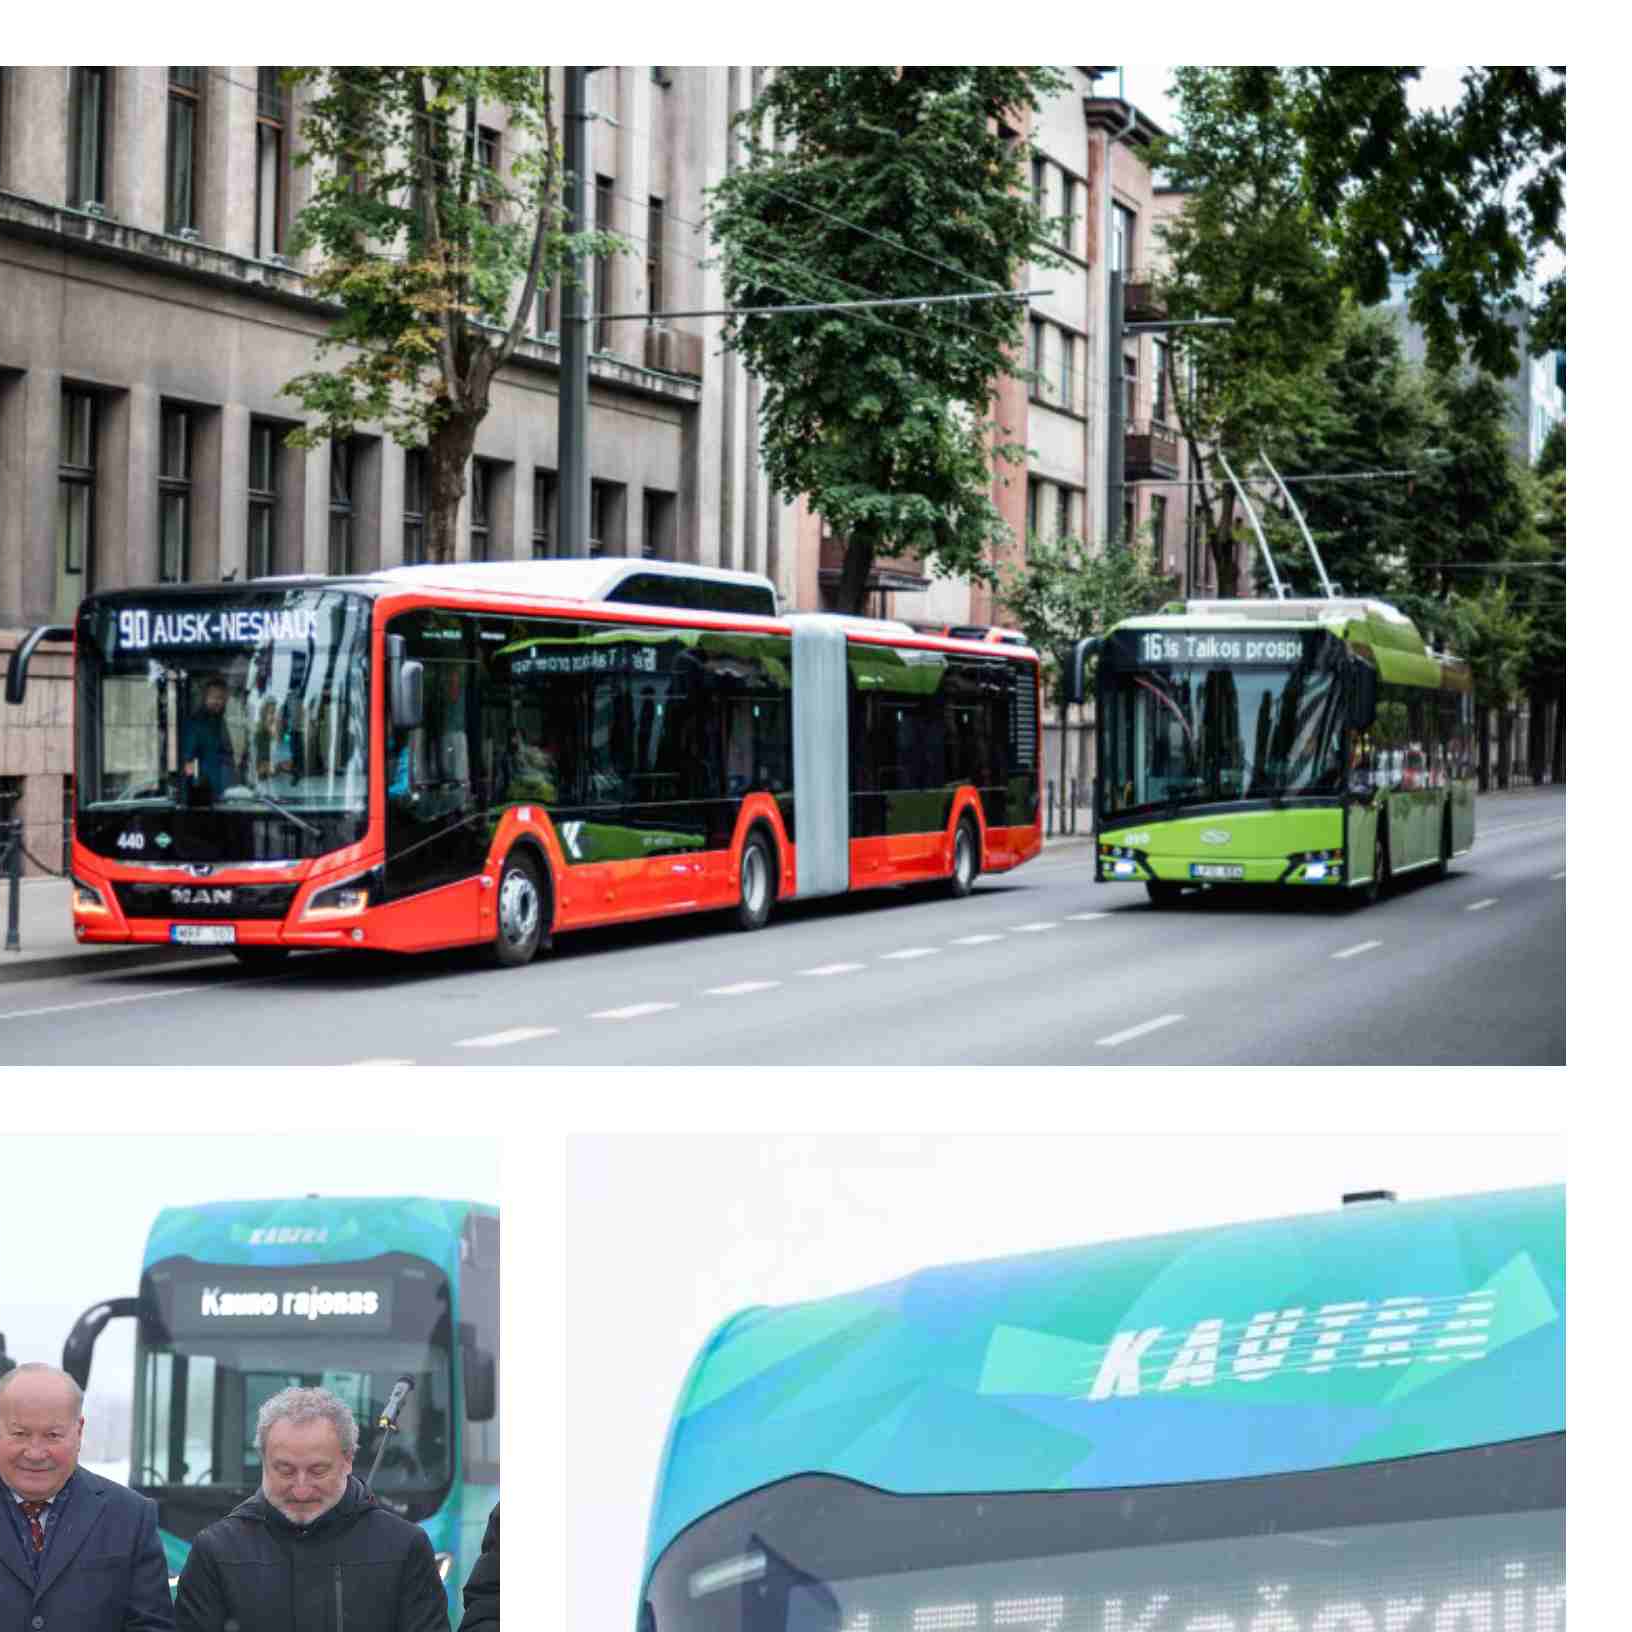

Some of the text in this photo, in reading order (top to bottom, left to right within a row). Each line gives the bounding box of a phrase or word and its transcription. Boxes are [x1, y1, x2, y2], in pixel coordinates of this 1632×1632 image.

[120, 609, 149, 649] 90
[1185, 635, 1241, 659] Taikos
[118, 832, 145, 850] 440
[170, 888, 233, 904] MAN
[201, 1285, 379, 1321] Kauno rajonas
[1088, 1289, 1497, 1403] KAUTRA
